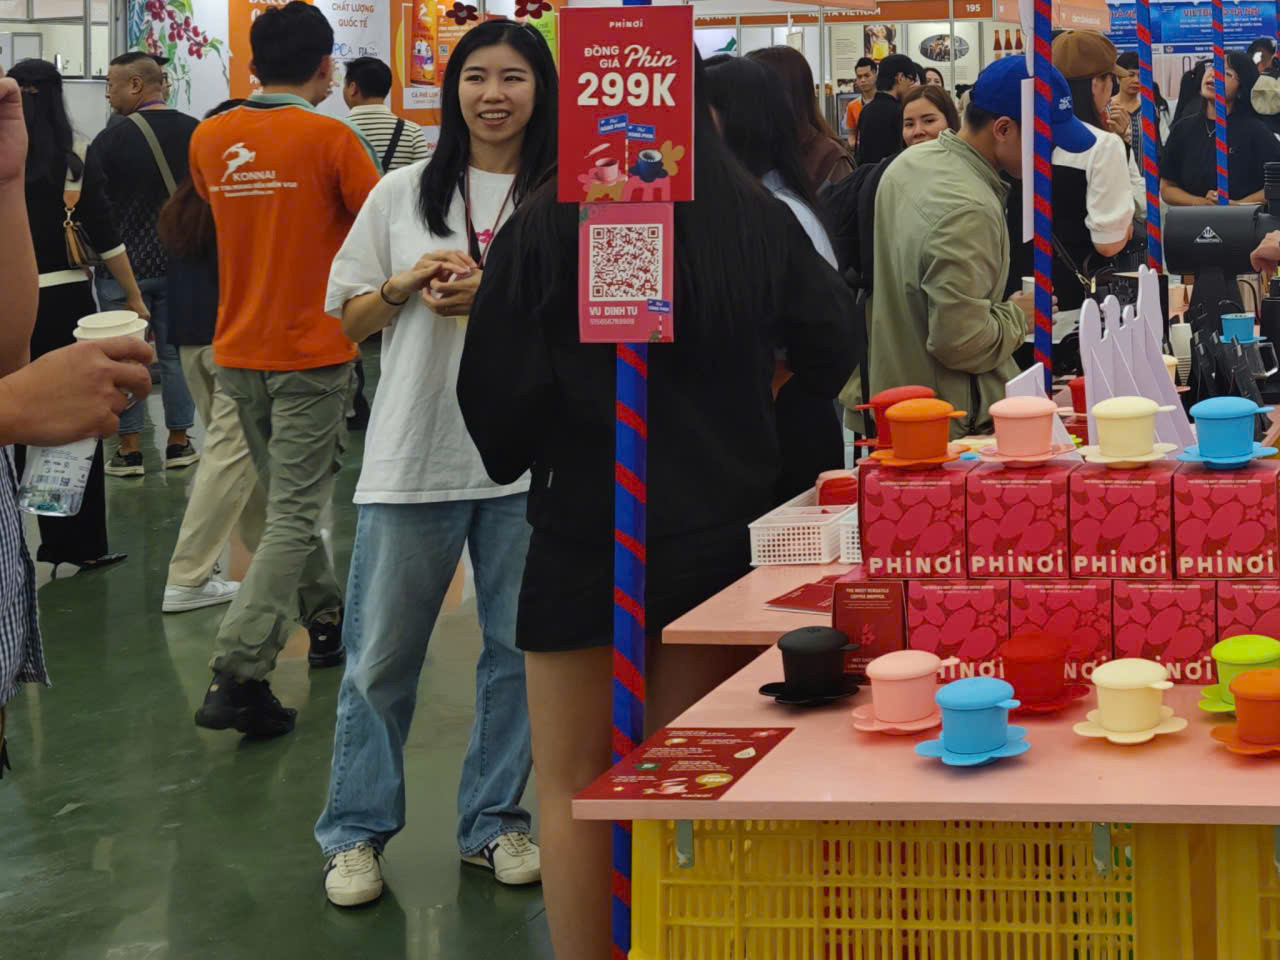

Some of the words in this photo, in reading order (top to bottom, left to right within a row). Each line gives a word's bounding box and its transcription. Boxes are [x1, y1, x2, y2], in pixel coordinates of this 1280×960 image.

[965, 3, 981, 12] 195
[584, 44, 619, 57] ĐỒNG
[624, 44, 677, 68] Phin
[599, 57, 620, 68] GIÁ
[577, 71, 676, 107] 299K
[232, 170, 276, 182] KONNAI
[589, 306, 602, 315] VU
[604, 306, 625, 315] DINH
[626, 306, 638, 315] TU
